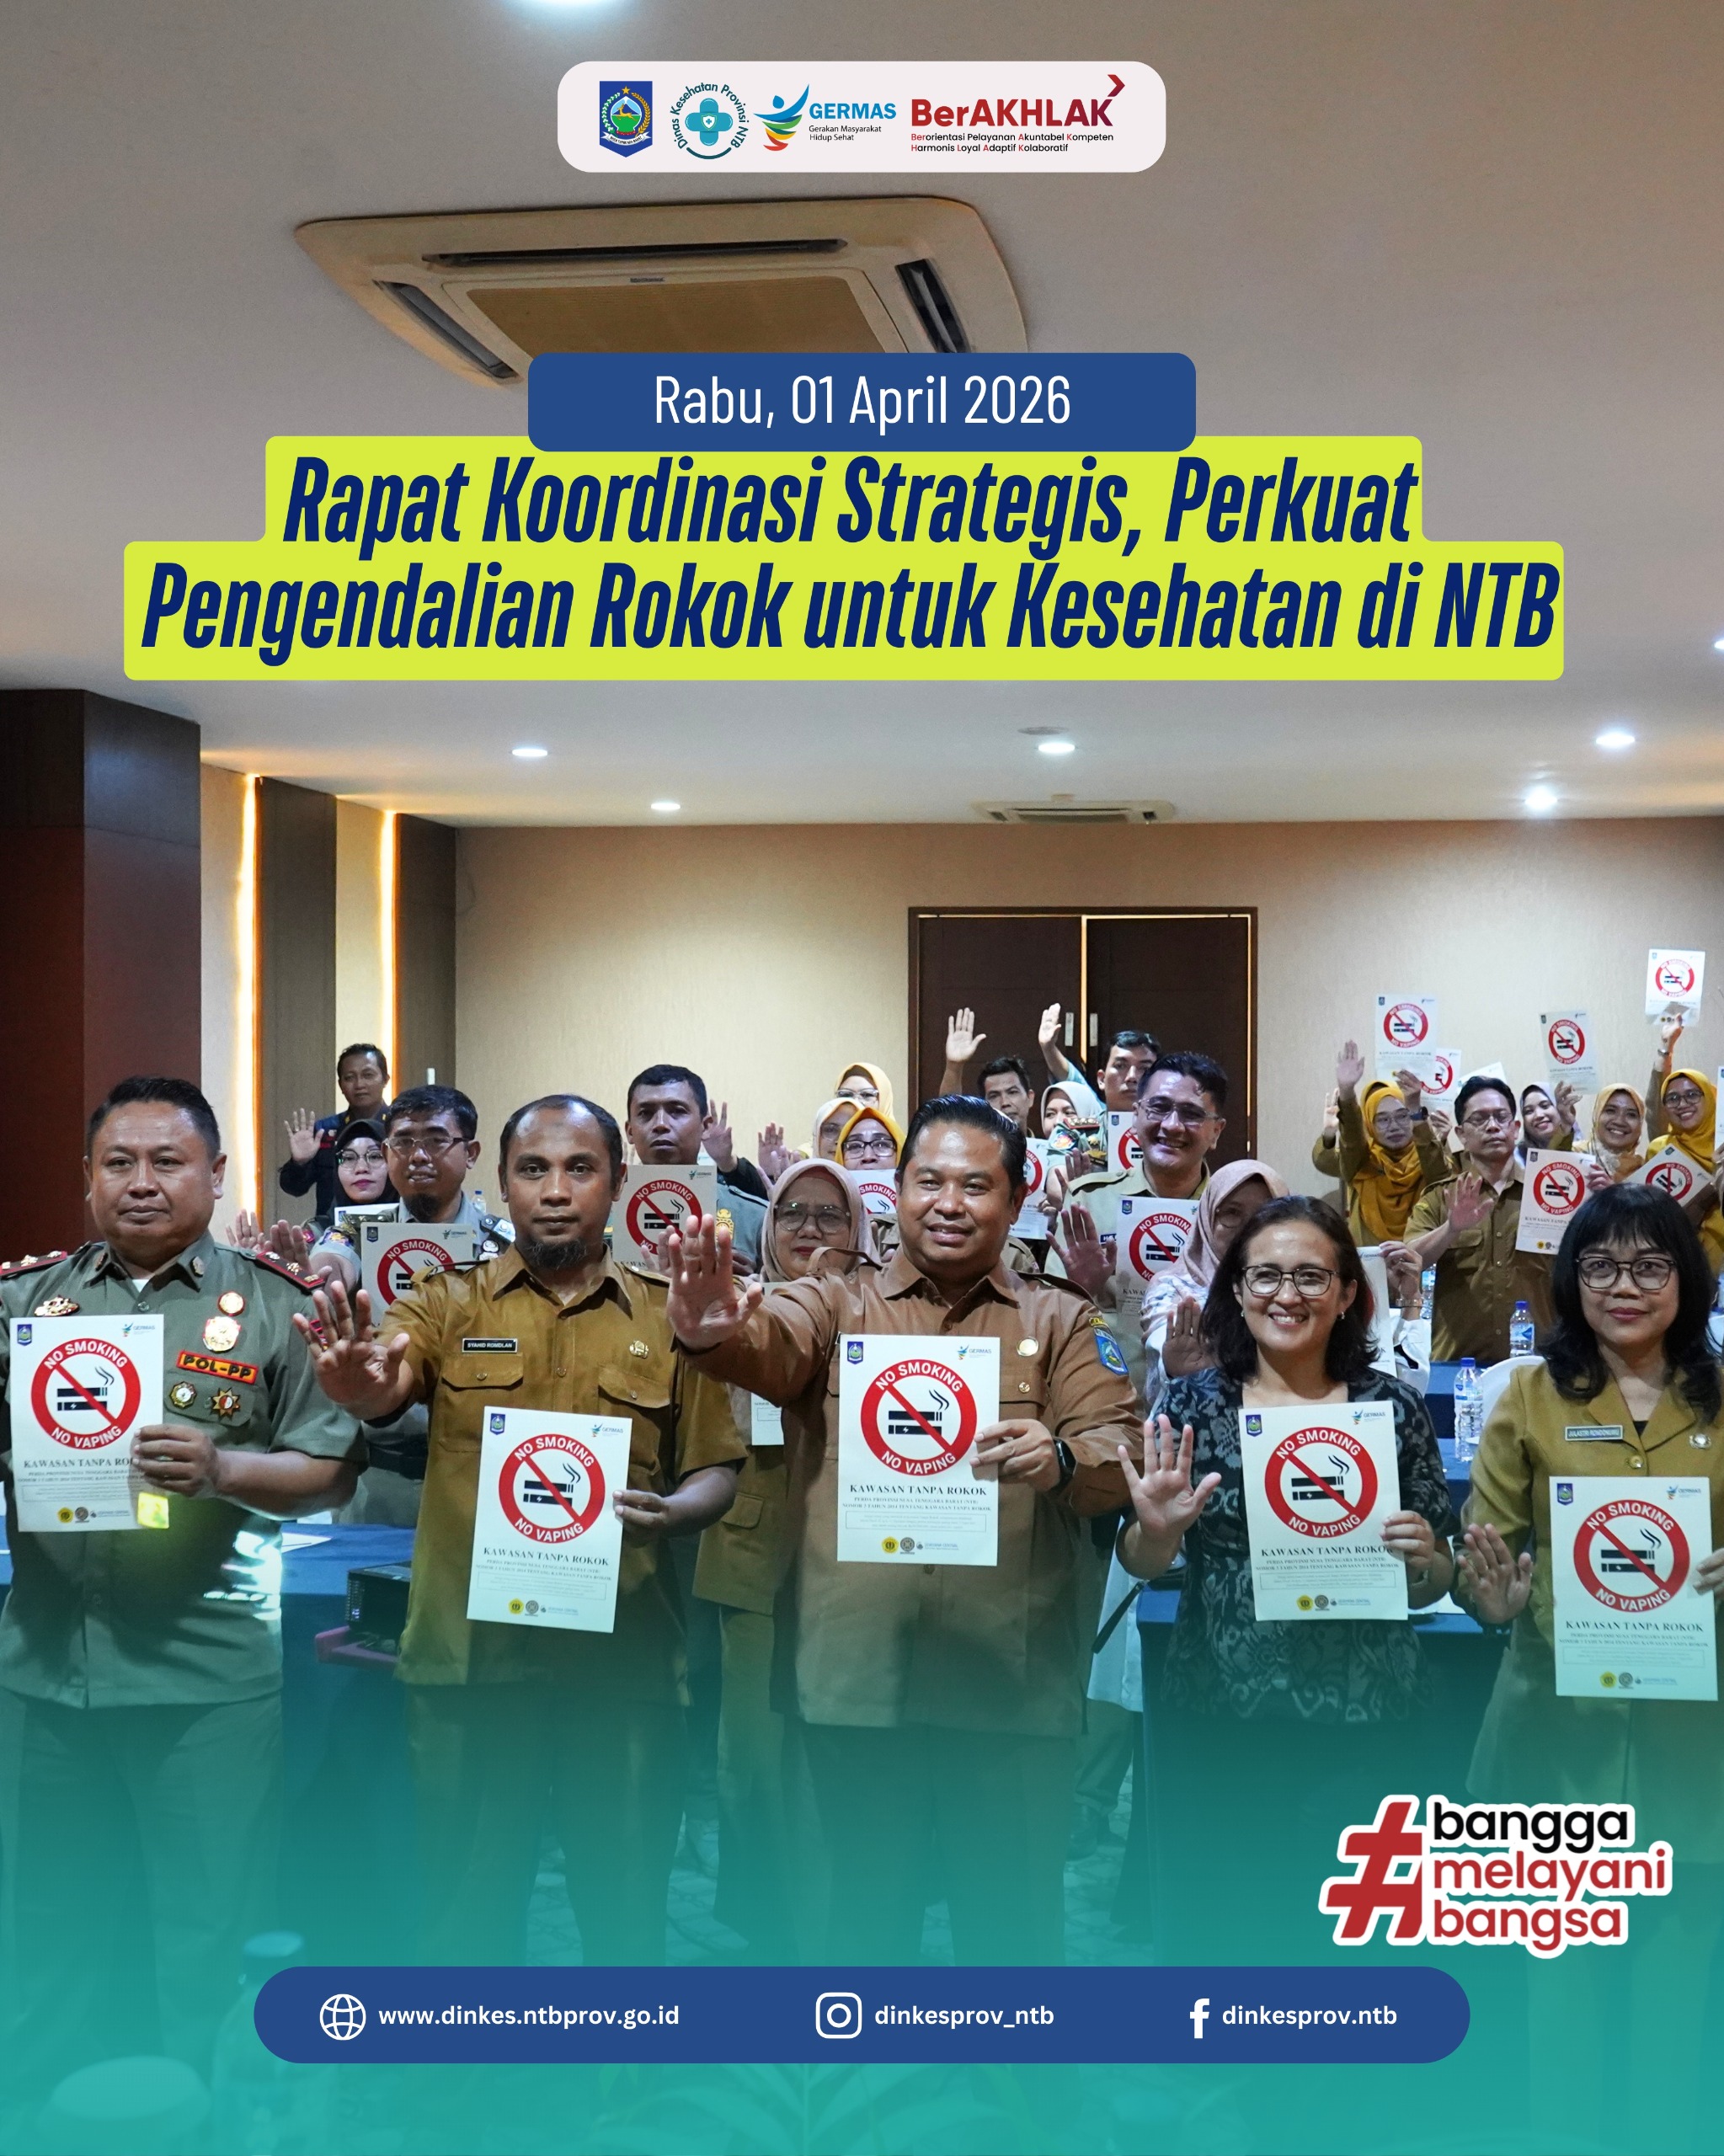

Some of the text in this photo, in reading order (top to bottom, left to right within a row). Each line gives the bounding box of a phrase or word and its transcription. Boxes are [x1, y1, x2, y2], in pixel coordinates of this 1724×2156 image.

[635, 1182, 693, 1202] NO SMOKING
[859, 1184, 897, 1201] SMOKING
[1139, 1219, 1152, 1232] NO
[387, 1241, 447, 1262] NO SMOKING
[45, 1342, 128, 1370] NO SMOKING
[184, 1355, 252, 1379] POL-PP
[875, 1361, 963, 1393] NO SMOKING
[51, 1425, 122, 1449] NO VAPING
[1276, 1429, 1361, 1460] NO SMOKING
[24, 1460, 75, 1468] KAWASAN
[78, 1459, 112, 1467] TANPA
[515, 1437, 595, 1467] NO SMOKING
[881, 1450, 956, 1475] NO VAPING
[850, 1485, 987, 1496] KAWASAN TANPA ROKOK
[1288, 1513, 1361, 1536] NO VAPING
[1587, 1502, 1674, 1531] NO SMOKING
[515, 1517, 584, 1542] NO VAPING
[483, 1547, 609, 1566] KAWASAN TANPA ROKOK
[1261, 1548, 1314, 1556] KAWASAN
[1316, 1546, 1352, 1555] TANPA
[1596, 1588, 1672, 1612] NO VAPING
[1566, 1620, 1704, 1632] KAWASAN TANPA ROKOK
